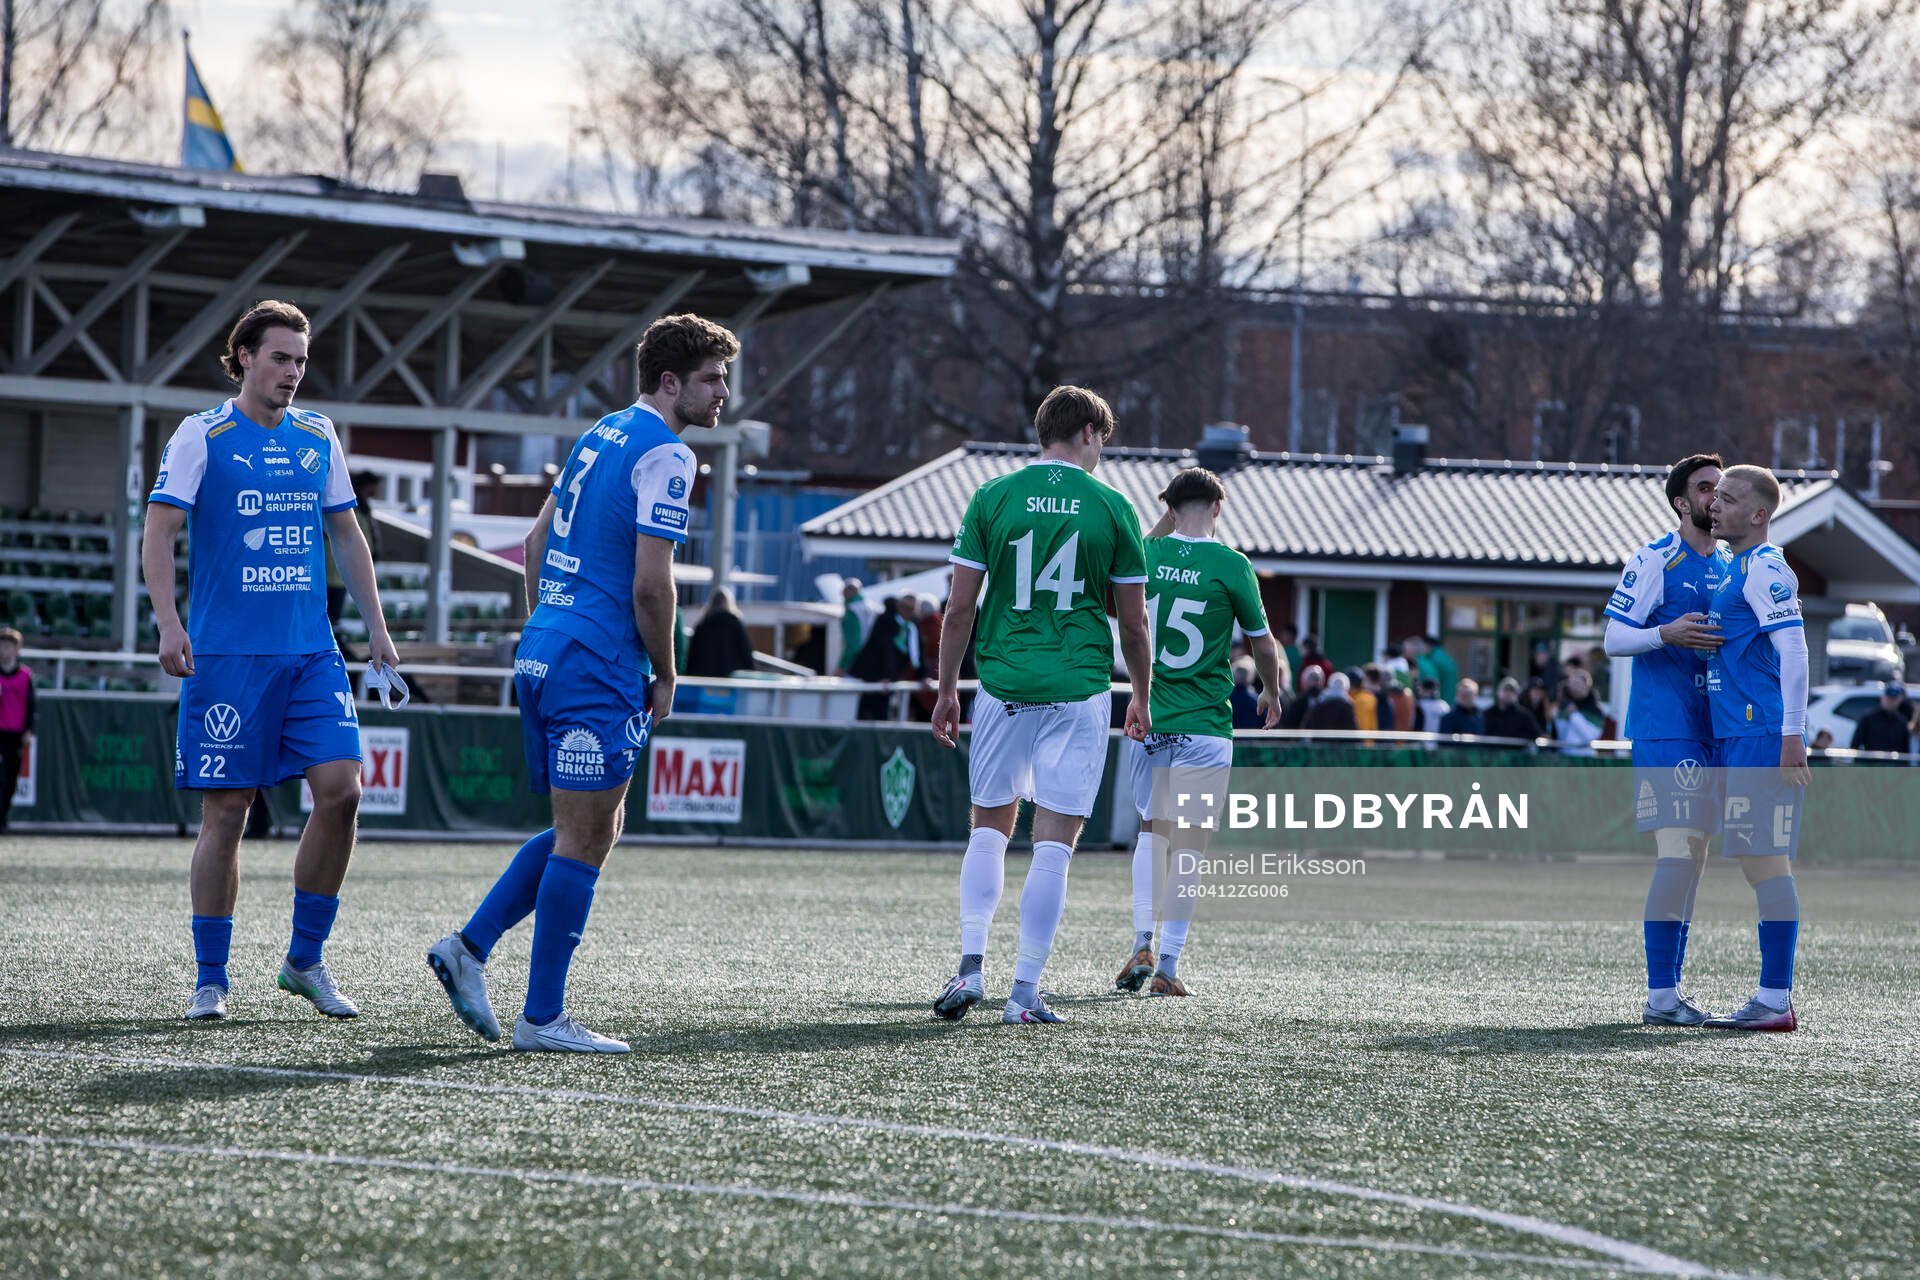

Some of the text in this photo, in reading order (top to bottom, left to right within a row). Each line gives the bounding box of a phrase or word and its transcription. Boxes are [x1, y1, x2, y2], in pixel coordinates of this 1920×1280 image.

[265, 492, 318, 501] MATTSSON
[553, 446, 600, 538] 3
[265, 502, 313, 511] GRUPPEN
[655, 506, 687, 521] UNIBET
[1026, 496, 1080, 515] SKILLE
[268, 526, 313, 546] EBC
[274, 547, 309, 555] GROUP
[1008, 528, 1085, 611] 14
[1155, 565, 1201, 586] STARK
[1146, 592, 1208, 670] 15
[199, 754, 226, 778] 22
[557, 750, 605, 764] BOHUS
[1672, 799, 1690, 820] 11
